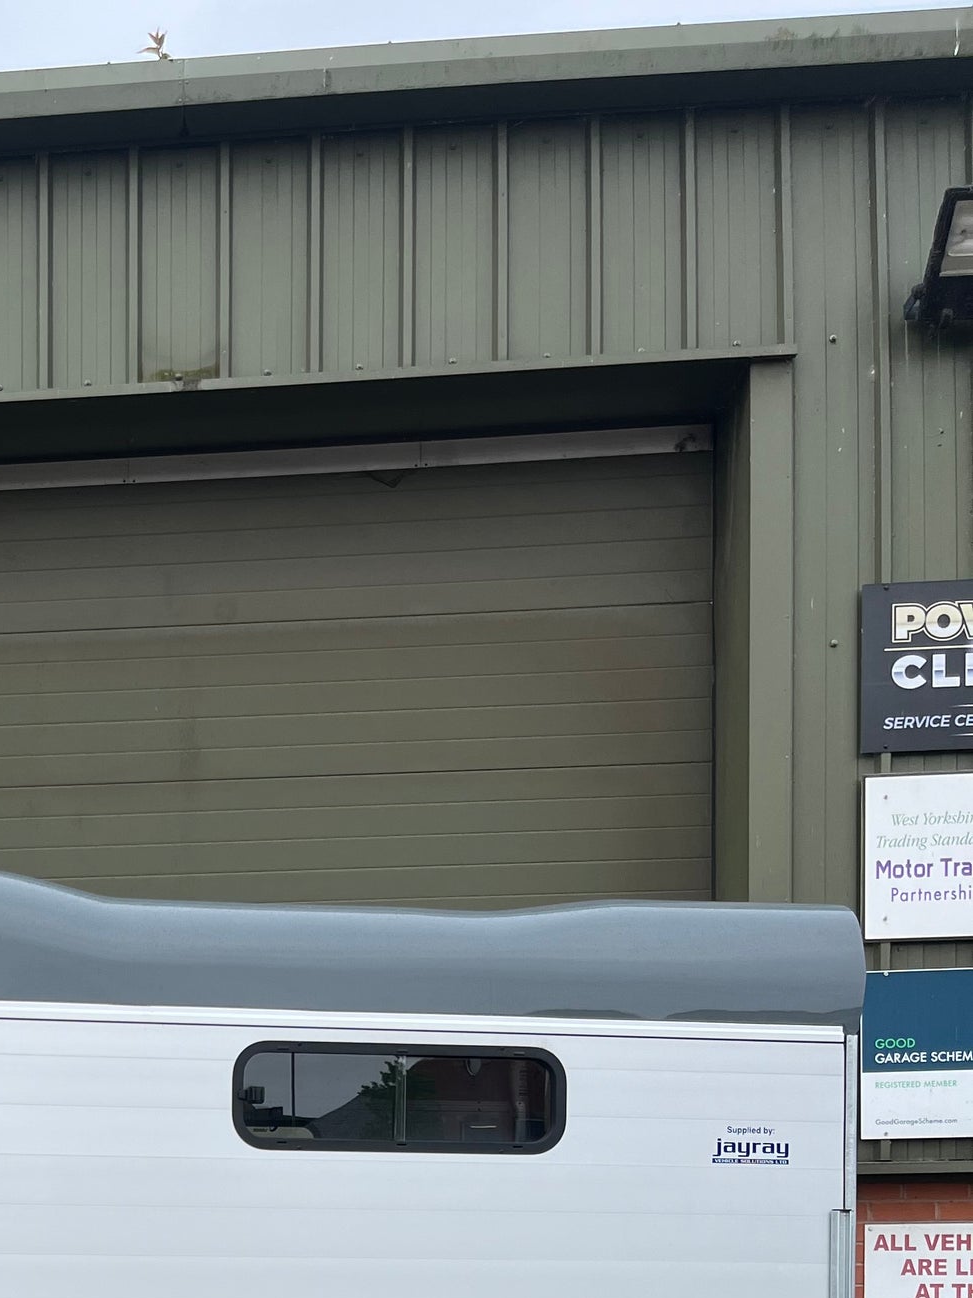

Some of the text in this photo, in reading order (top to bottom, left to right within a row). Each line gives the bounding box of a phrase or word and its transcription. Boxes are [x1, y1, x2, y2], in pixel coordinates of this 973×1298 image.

[883, 715, 951, 730] SERVICE
[891, 814, 919, 826] West
[876, 834, 927, 850] Trading
[876, 858, 973, 879] Motor Tra
[891, 884, 972, 902] Partnershi
[875, 1038, 916, 1049] GOOD
[875, 1051, 973, 1064] GARAGE SCHEM
[875, 1080, 957, 1089] REGISTERED MEMBER
[727, 1126, 775, 1136] Supplied by:
[712, 1138, 789, 1158] jayray
[874, 1234, 972, 1251] ALL VEH
[901, 1259, 947, 1276] ARE
